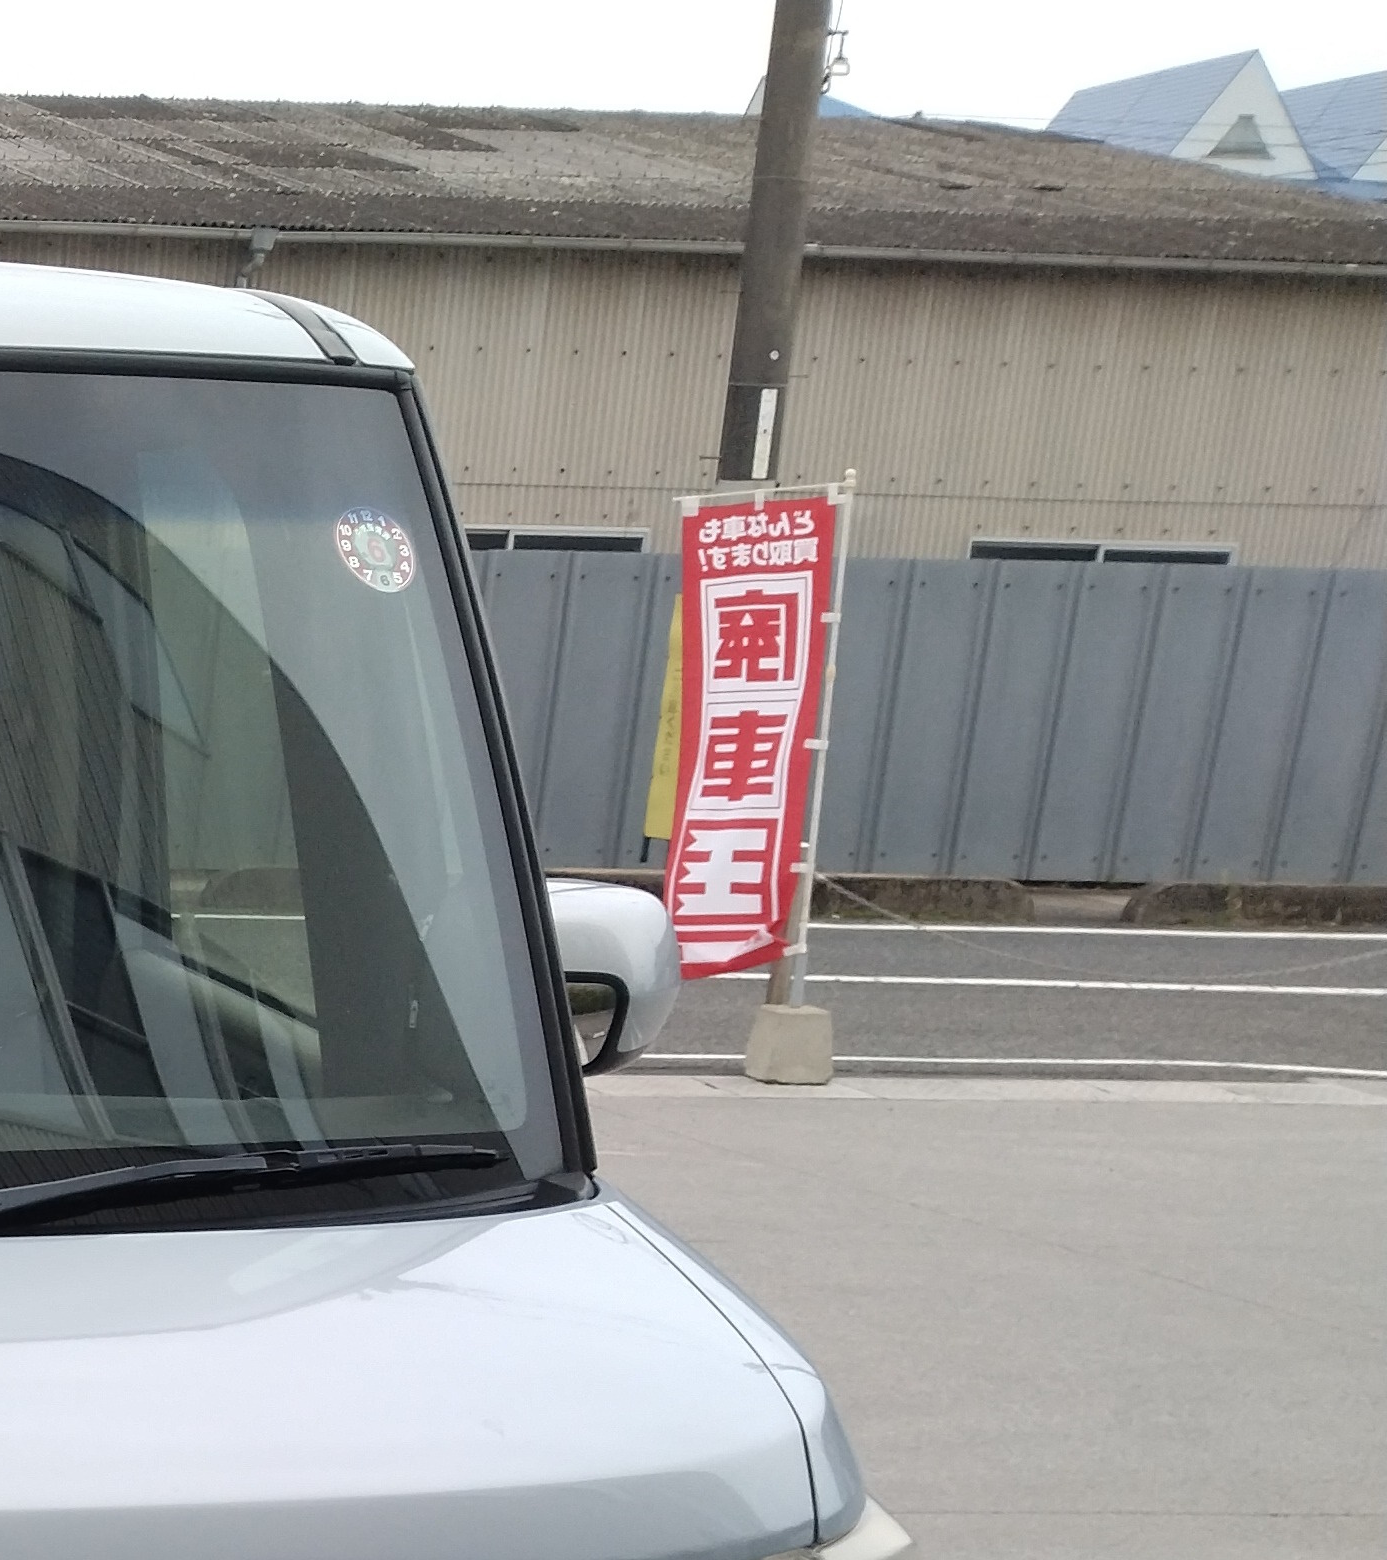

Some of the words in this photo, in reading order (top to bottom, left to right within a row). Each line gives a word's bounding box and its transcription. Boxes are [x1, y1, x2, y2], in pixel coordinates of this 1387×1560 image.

[377, 515, 387, 527] 1
[339, 524, 353, 537] 10
[391, 527, 403, 540] 2
[340, 539, 353, 552] 9
[398, 544, 410, 557] 3
[348, 556, 360, 568] 8
[400, 561, 411, 573] 4
[362, 569, 373, 581] 7
[392, 571, 404, 584] 5
